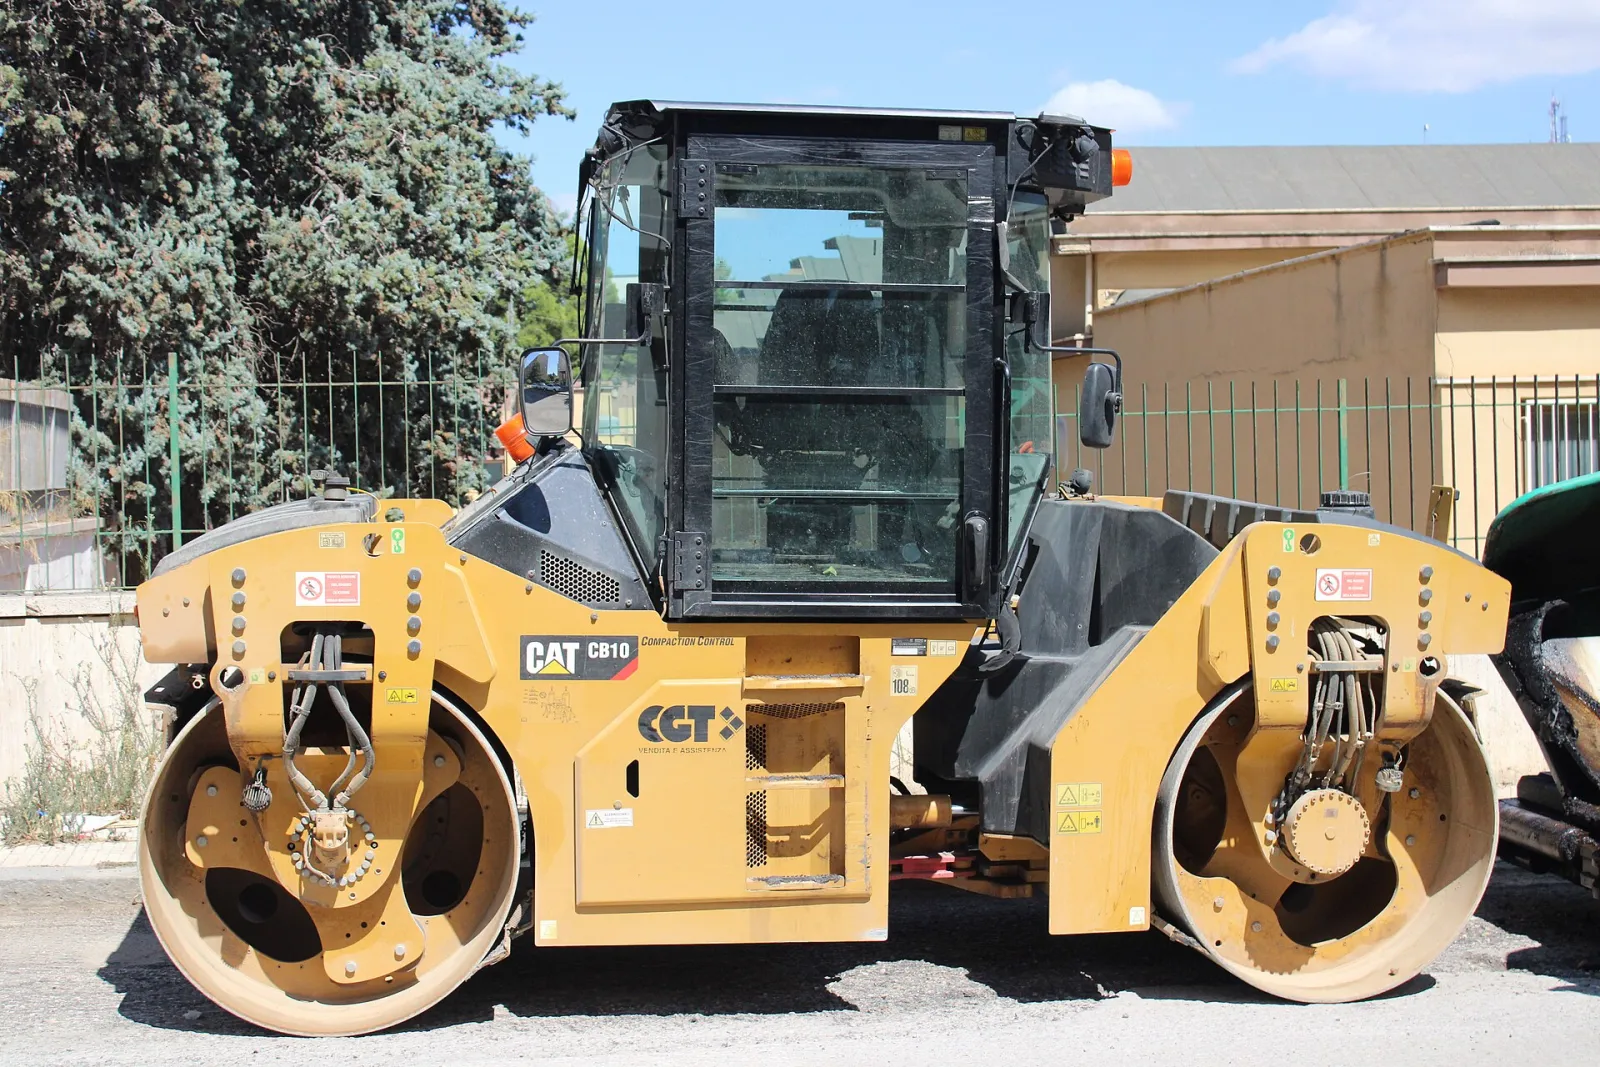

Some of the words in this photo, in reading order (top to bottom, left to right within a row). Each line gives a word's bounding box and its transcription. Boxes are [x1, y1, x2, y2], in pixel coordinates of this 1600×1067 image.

[526, 641, 580, 674] CAT
[587, 642, 630, 659] CB10
[892, 678, 909, 694] 108
[638, 705, 716, 742] CGT
